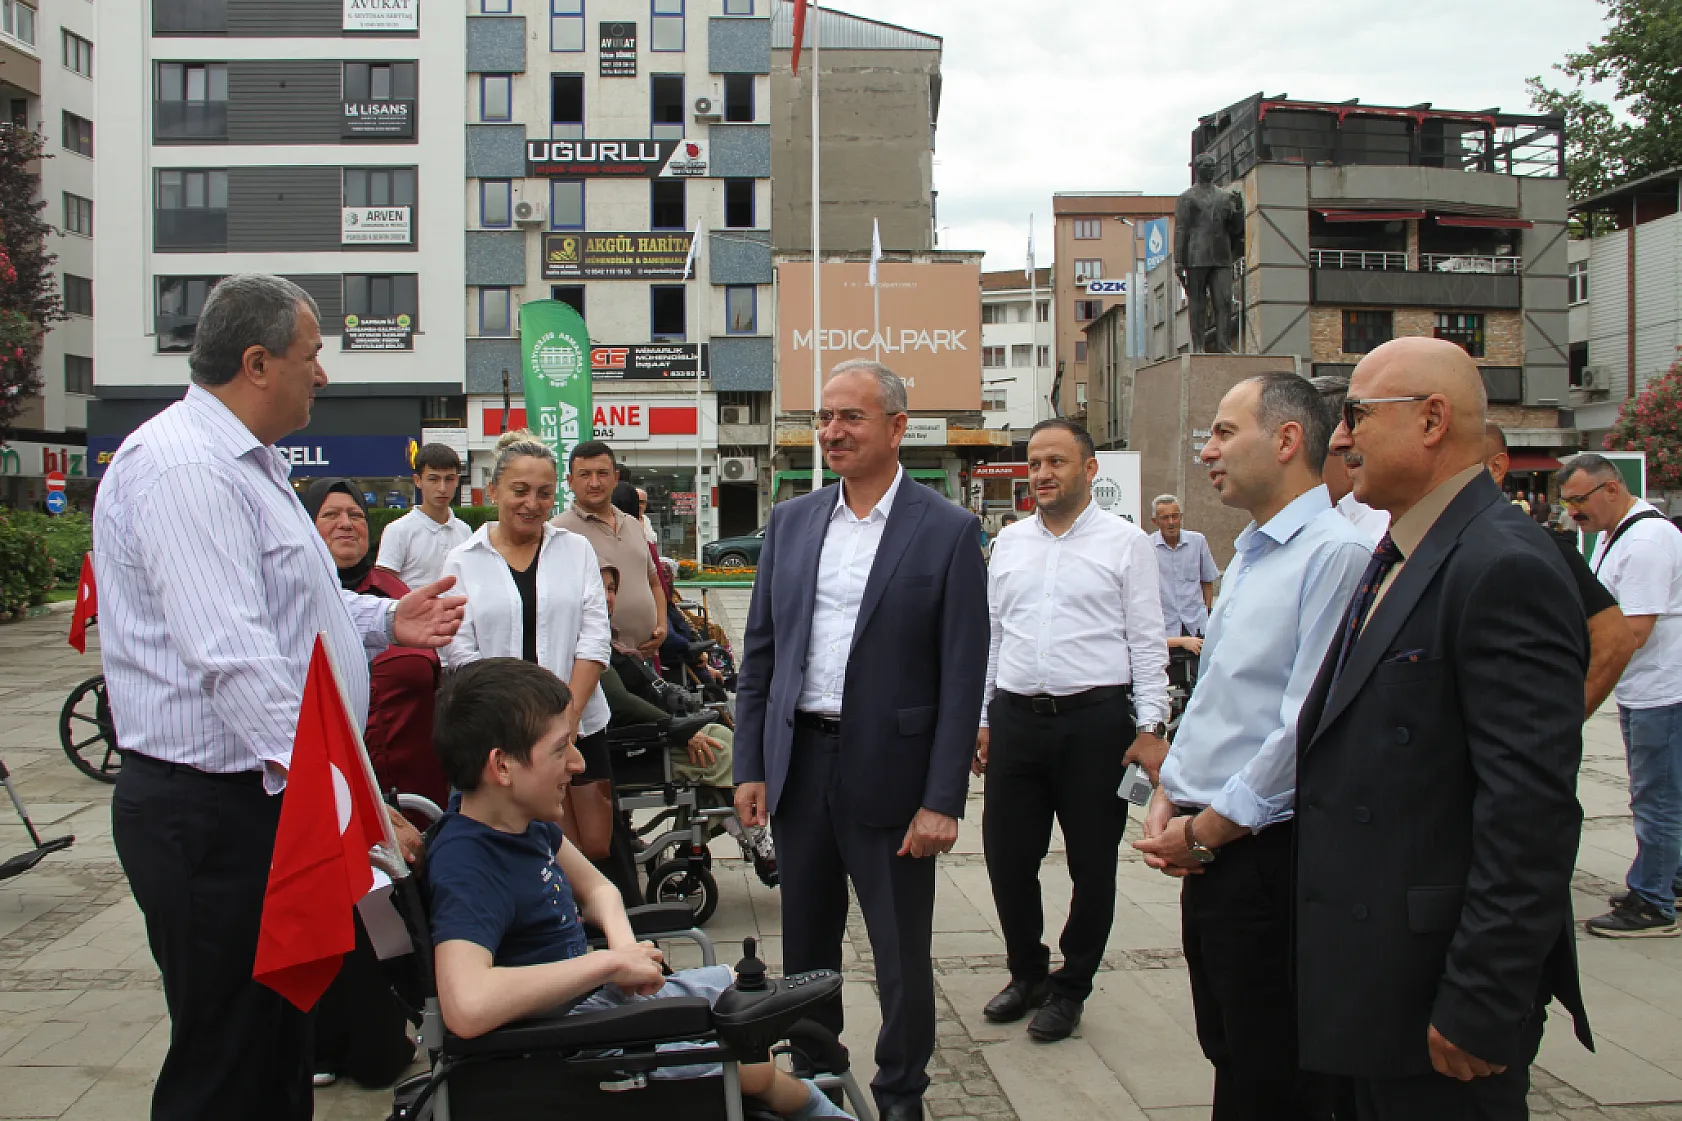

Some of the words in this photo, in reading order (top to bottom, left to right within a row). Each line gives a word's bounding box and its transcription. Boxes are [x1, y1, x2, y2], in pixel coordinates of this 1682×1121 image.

[528, 141, 660, 162] UĞURLU
[366, 210, 403, 221] ARVEN
[586, 235, 634, 252] AKGÜL
[637, 235, 691, 252] HARİTA
[642, 256, 687, 265] DANIŞMANL
[1090, 281, 1126, 292] ÖZK
[594, 405, 640, 426] ANE
[593, 428, 615, 439] DAŞ
